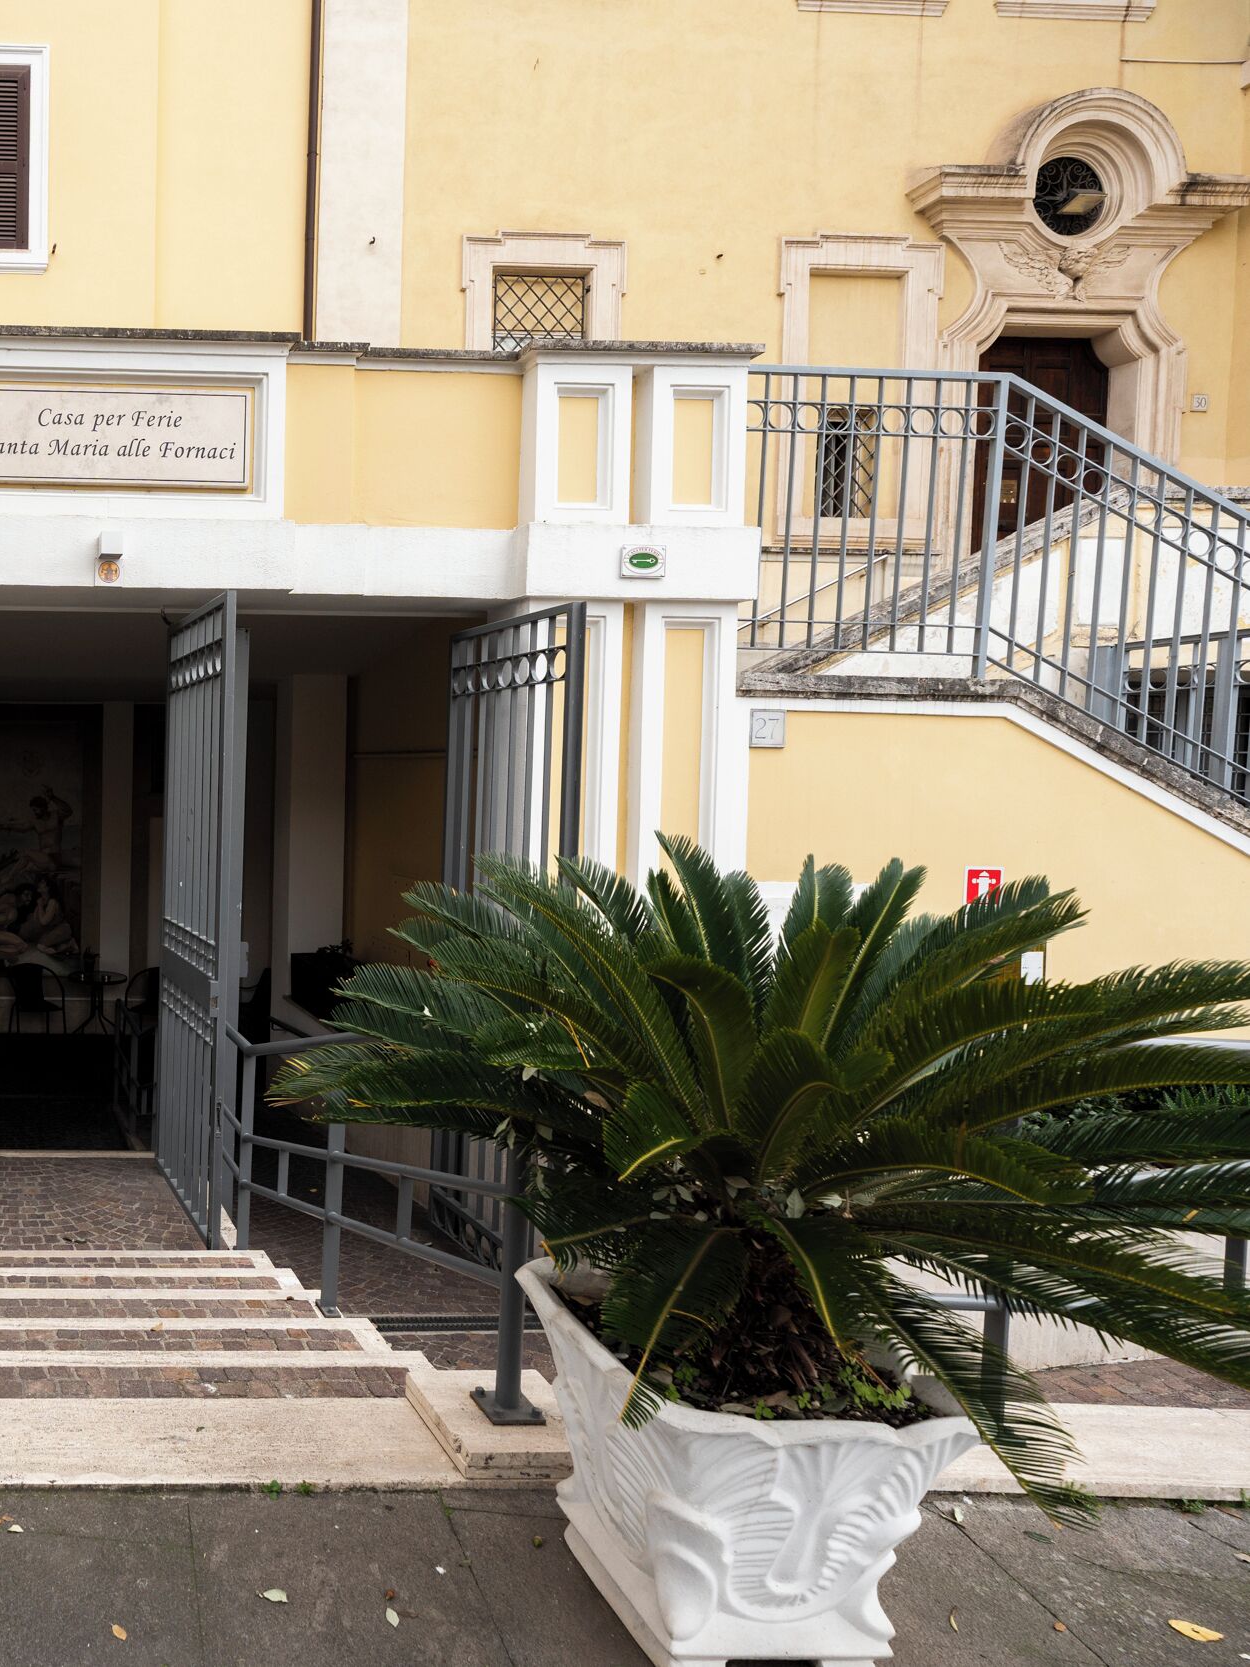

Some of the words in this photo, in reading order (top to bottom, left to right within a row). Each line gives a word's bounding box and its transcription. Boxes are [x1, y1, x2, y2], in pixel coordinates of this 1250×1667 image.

[1194, 396, 1207, 408] 30
[37, 408, 85, 427] Casa
[91, 413, 126, 432] per
[131, 410, 183, 428] Ferie
[48, 438, 109, 457] Maria
[116, 438, 151, 458] alle
[159, 441, 237, 460] Fornaci
[754, 717, 780, 739] 27
